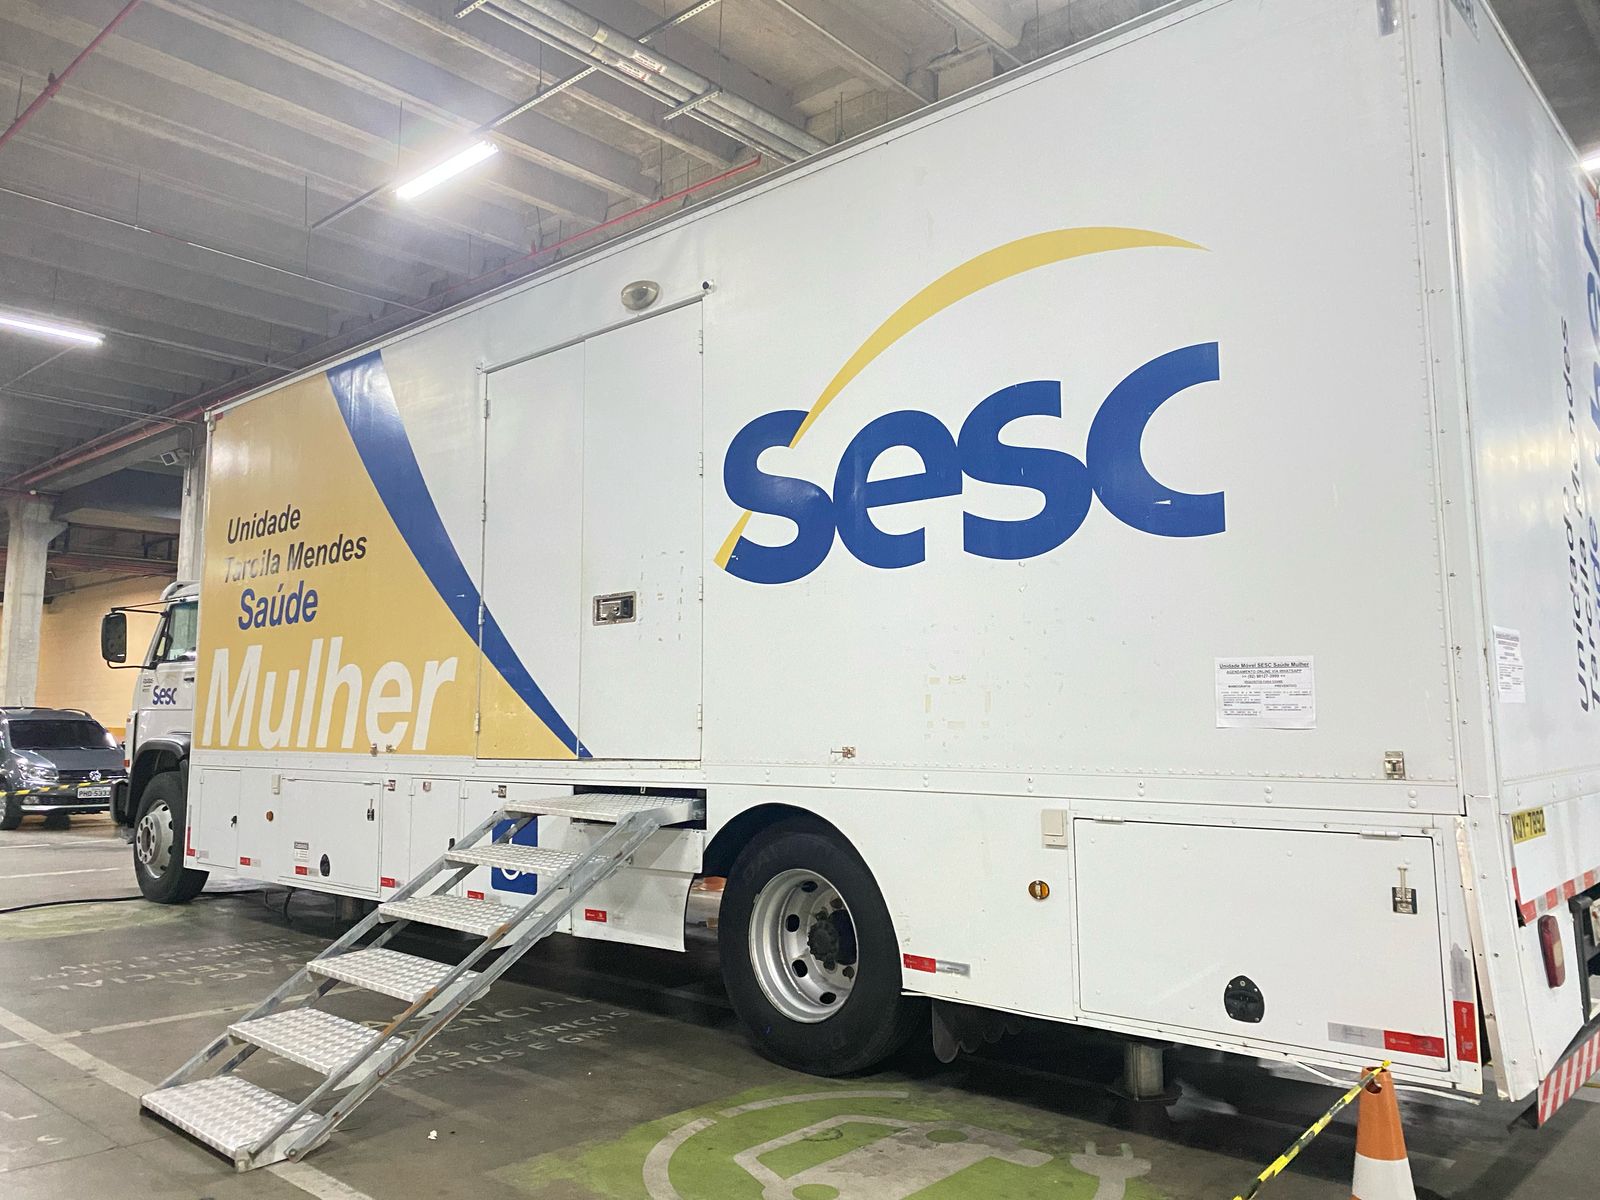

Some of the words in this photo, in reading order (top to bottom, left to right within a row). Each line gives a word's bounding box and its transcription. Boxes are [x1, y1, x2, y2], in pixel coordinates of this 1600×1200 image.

[227, 504, 301, 544] Unidade
[224, 548, 280, 583] Tarcila
[286, 533, 368, 572] Mendes
[238, 580, 318, 630] Saúde
[1562, 486, 1589, 712] Unidade
[201, 636, 458, 751] Mulher
